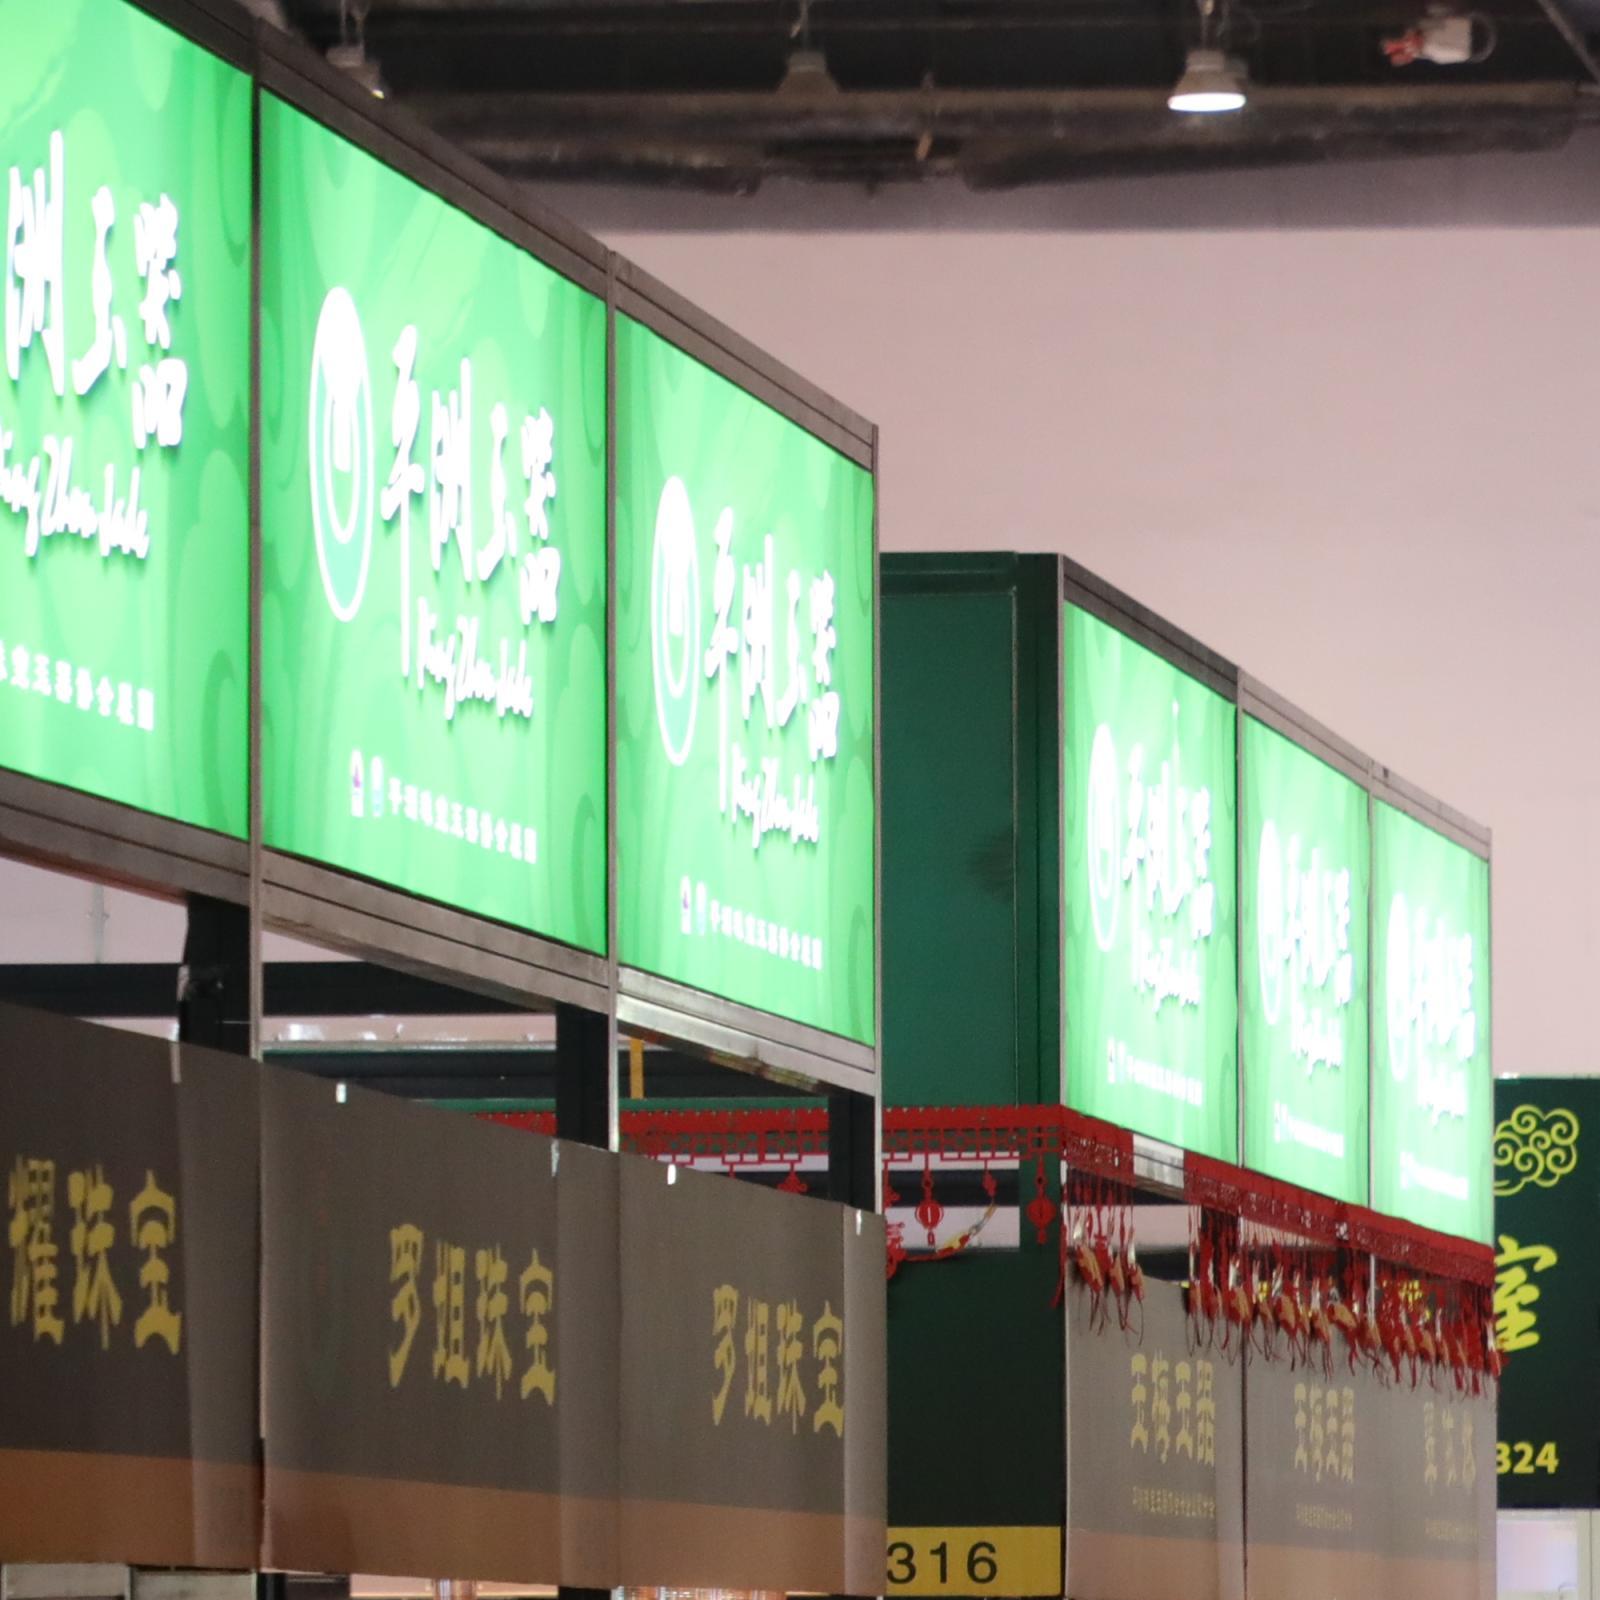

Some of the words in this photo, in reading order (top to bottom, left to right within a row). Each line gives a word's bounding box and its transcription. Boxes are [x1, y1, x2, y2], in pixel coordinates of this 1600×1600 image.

[390, 1223, 556, 1404] 罗姐珠宝
[712, 1284, 844, 1438] 罗姐珠宝
[1496, 1442, 1559, 1474] 324
[887, 1541, 998, 1584] 316
